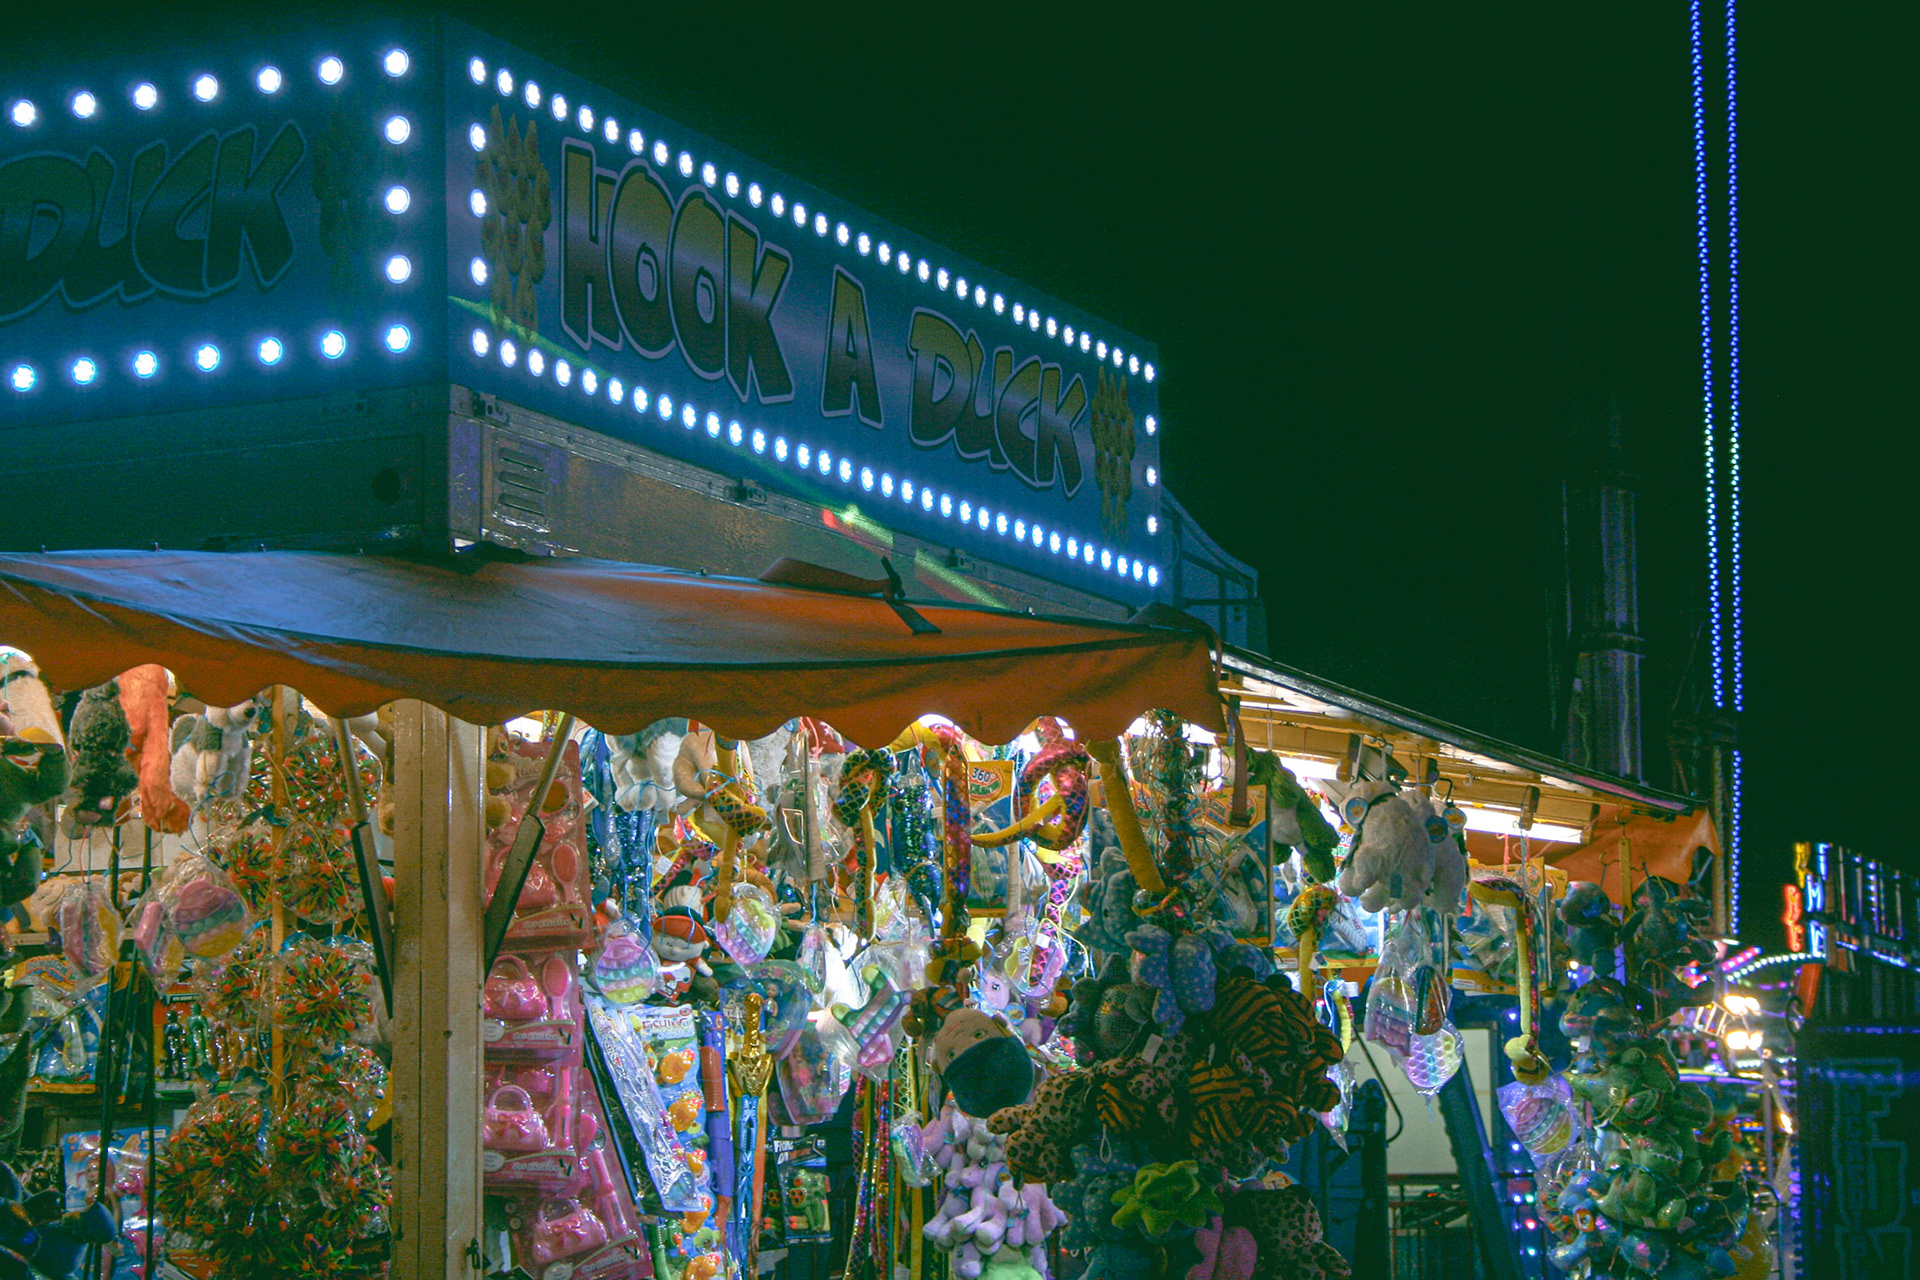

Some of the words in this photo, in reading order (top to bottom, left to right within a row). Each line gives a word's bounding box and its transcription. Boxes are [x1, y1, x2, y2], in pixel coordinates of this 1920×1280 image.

[560, 137, 795, 404] HOOK
[820, 264, 885, 430] A
[907, 306, 1088, 498] DUCK
[641, 1017, 690, 1031] FISHING
